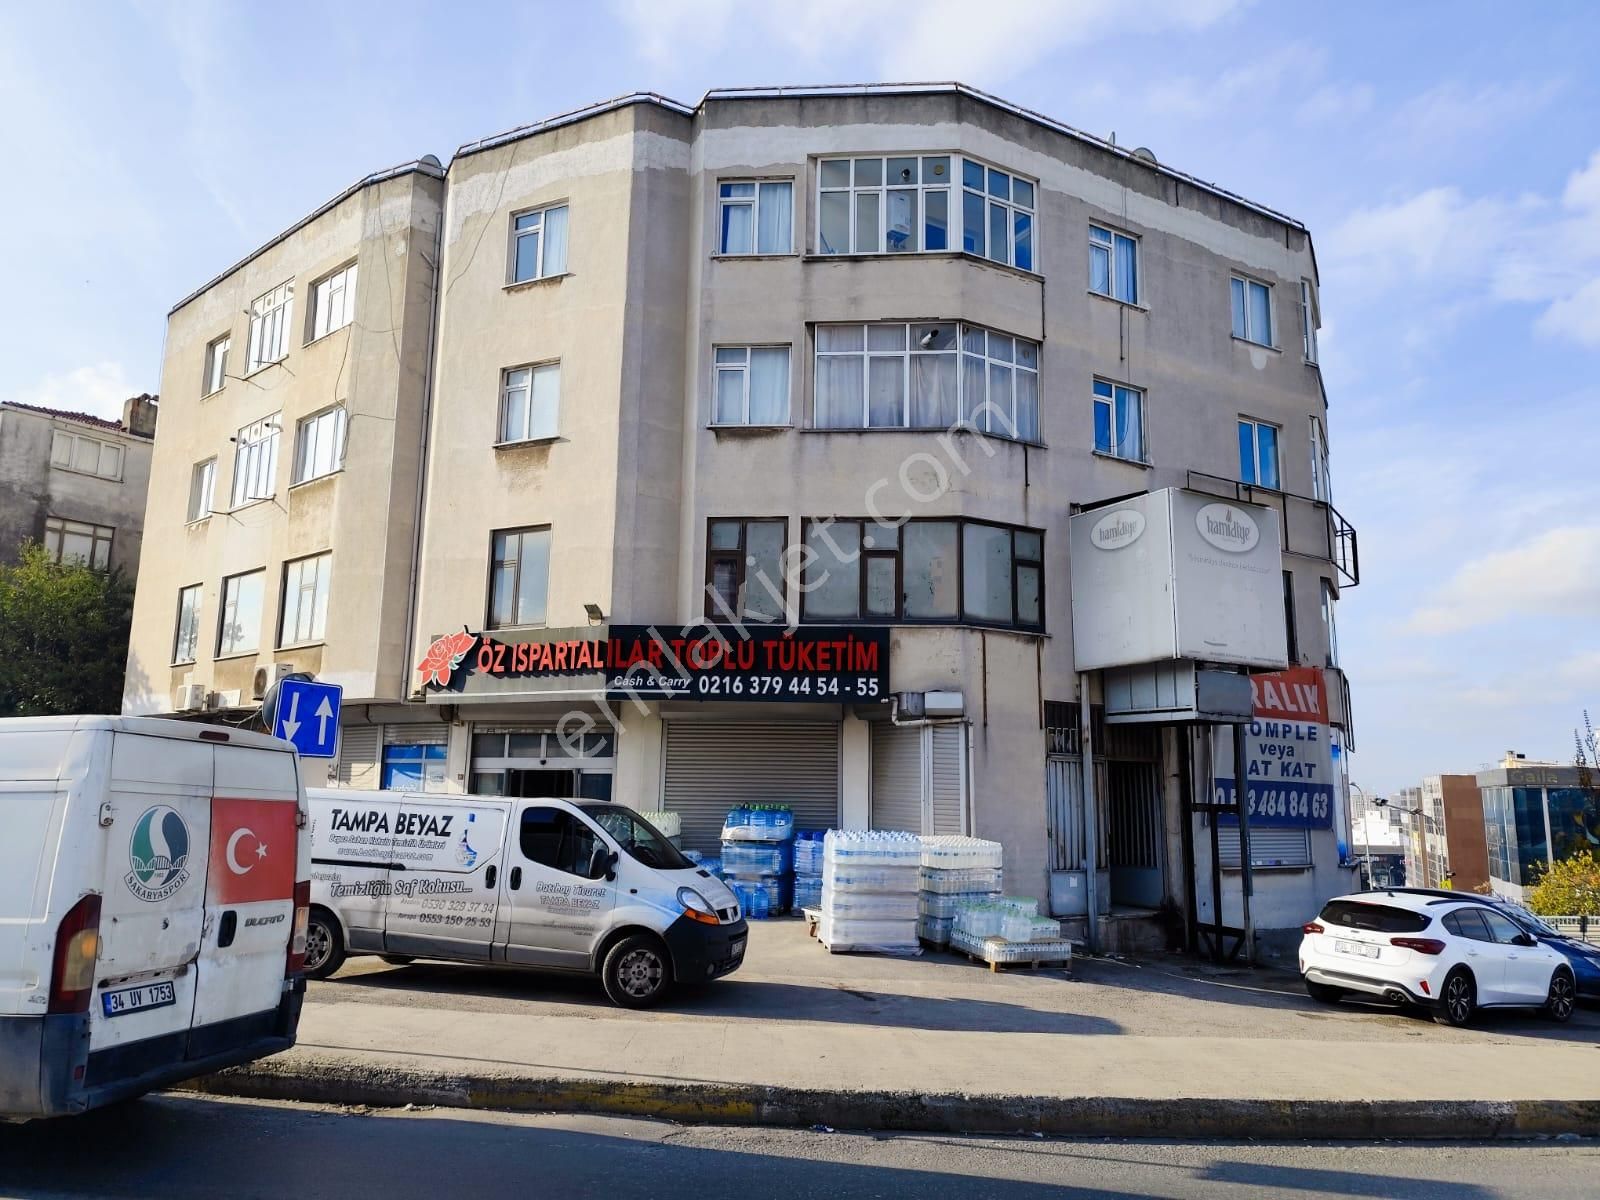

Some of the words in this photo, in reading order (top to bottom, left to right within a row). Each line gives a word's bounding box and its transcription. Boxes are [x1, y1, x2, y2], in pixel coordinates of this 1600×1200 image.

[1206, 516, 1250, 544] hamidiye
[477, 637, 506, 673] ÖZ
[670, 639, 755, 671] TOPLU
[762, 632, 879, 672] TÜKETİM
[614, 675, 644, 687] Cash
[646, 676, 655, 686] &
[657, 675, 691, 688] Carry
[699, 675, 743, 694] 0216
[750, 676, 783, 695] 379
[788, 677, 811, 695] 44
[816, 677, 839, 695] 54
[857, 677, 879, 696] 55
[1245, 720, 1318, 741] OMPLE
[1259, 744, 1295, 760] veya
[1248, 760, 1272, 776] AT
[1280, 761, 1316, 779] KAT
[1258, 790, 1286, 816] 484
[1289, 790, 1309, 818] 84
[1312, 792, 1328, 819] 63
[331, 809, 389, 834] TAMPA
[394, 813, 455, 837] BEYAZ
[127, 873, 187, 900] SAKARYASPOR
[331, 879, 392, 899] Temizliğin
[394, 879, 418, 899] Saf
[540, 895, 570, 906] TAMPA
[571, 898, 601, 910] BEYAZ
[419, 913, 443, 925] 0553
[445, 914, 463, 926] 150
[112, 994, 124, 1009] 34
[149, 985, 172, 1003] 1753
